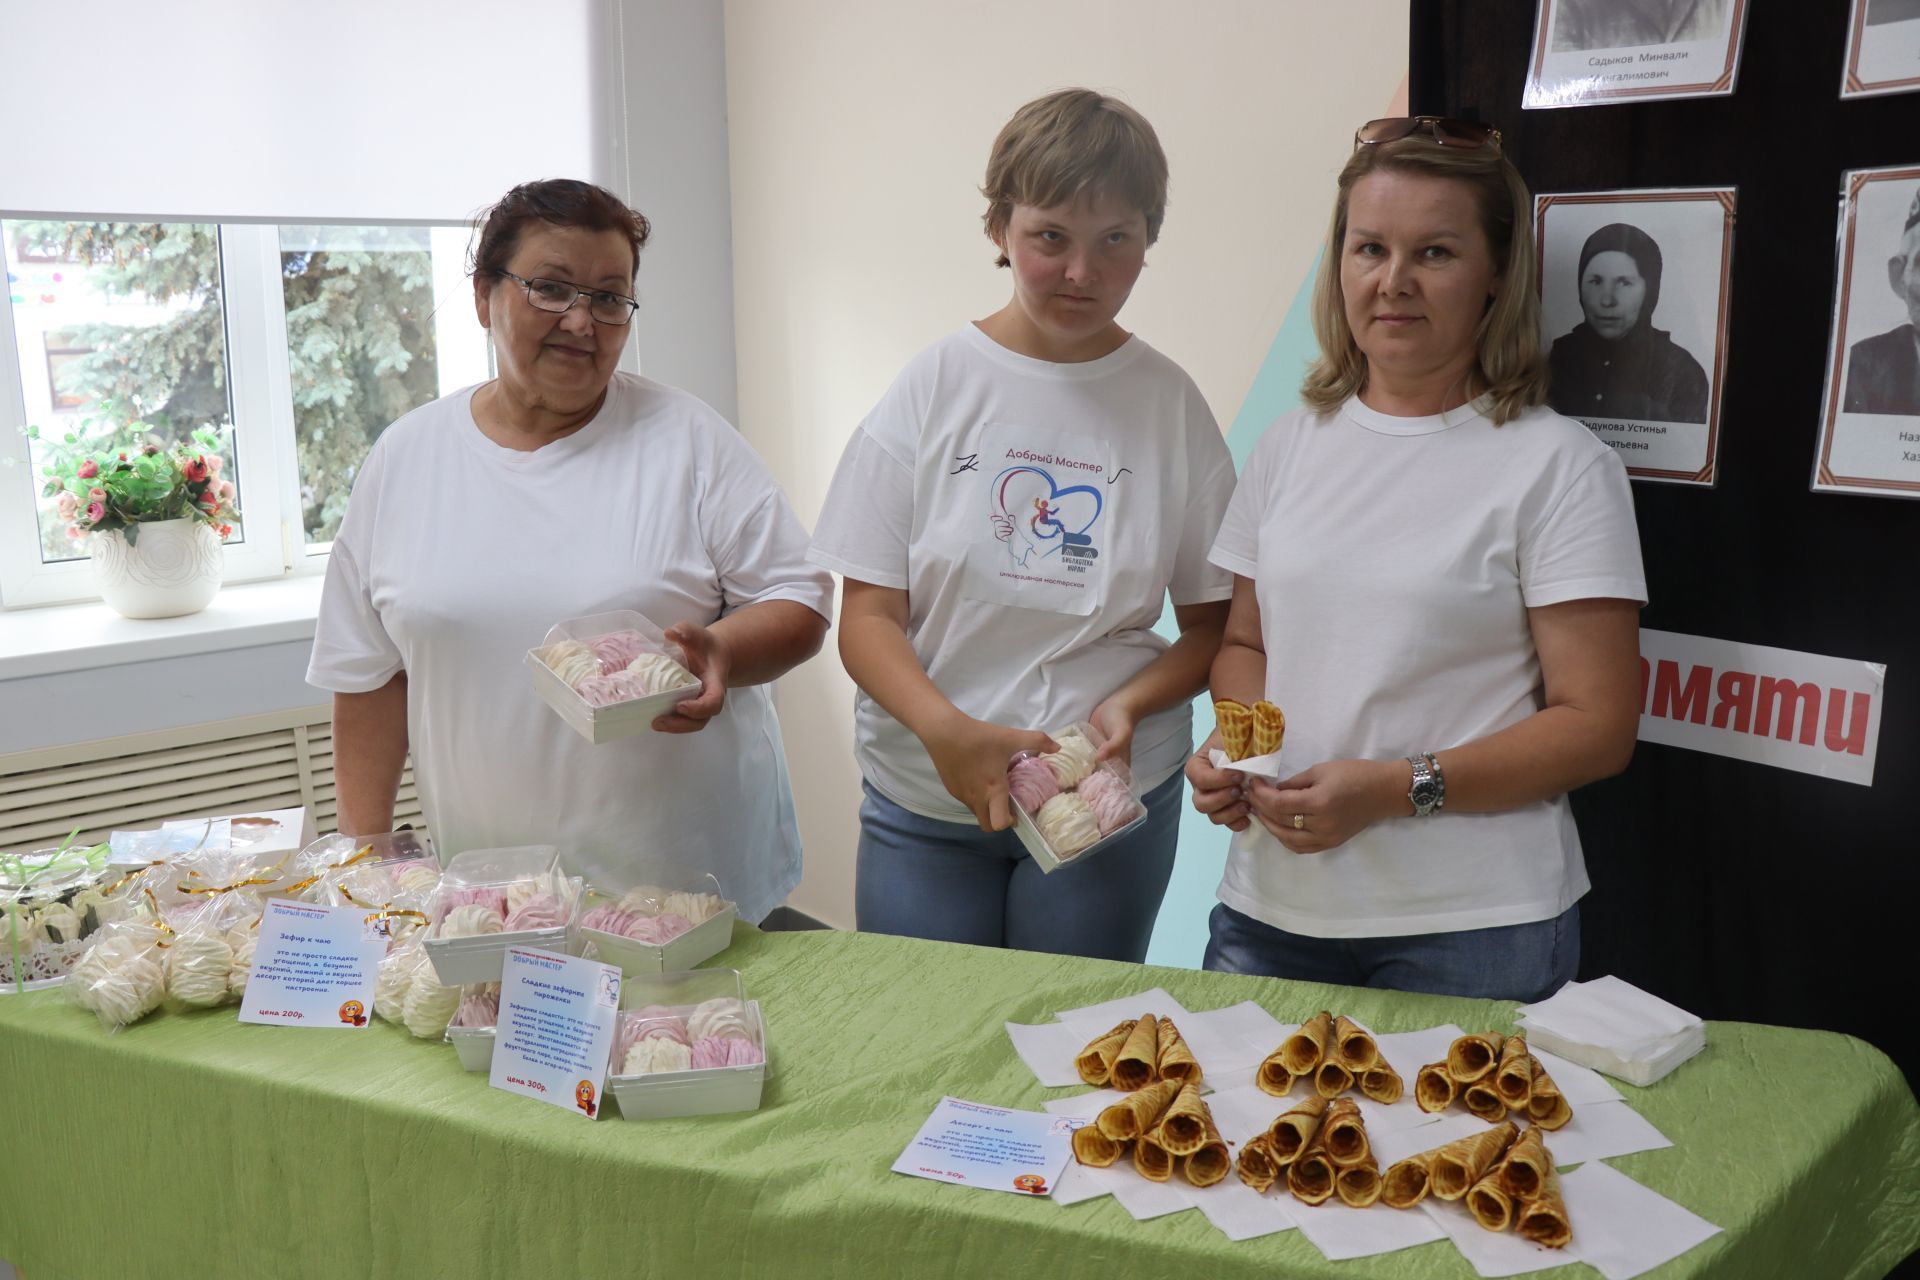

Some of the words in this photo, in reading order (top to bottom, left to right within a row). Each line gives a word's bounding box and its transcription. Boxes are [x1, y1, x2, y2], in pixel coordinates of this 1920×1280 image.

[1589, 56, 1633, 67] Садыков
[1639, 51, 1688, 62] Минвали
[1590, 70, 1669, 82] нгалимович
[1627, 424, 1666, 434] Устинья
[1006, 448, 1052, 464] Добрый
[1056, 456, 1102, 473] Мастер
[280, 933, 305, 943] Зефир
[513, 955, 540, 965] ДОБРЫЙ
[540, 961, 562, 970] МАСТЕР
[332, 972, 362, 980] вкусный
[522, 977, 551, 989] Сладкие
[282, 1011, 304, 1019] 200р.
[507, 1076, 525, 1085] цена
[527, 1079, 547, 1092] 300р.
[920, 1166, 943, 1174] цена
[947, 1171, 966, 1179] 50р.
